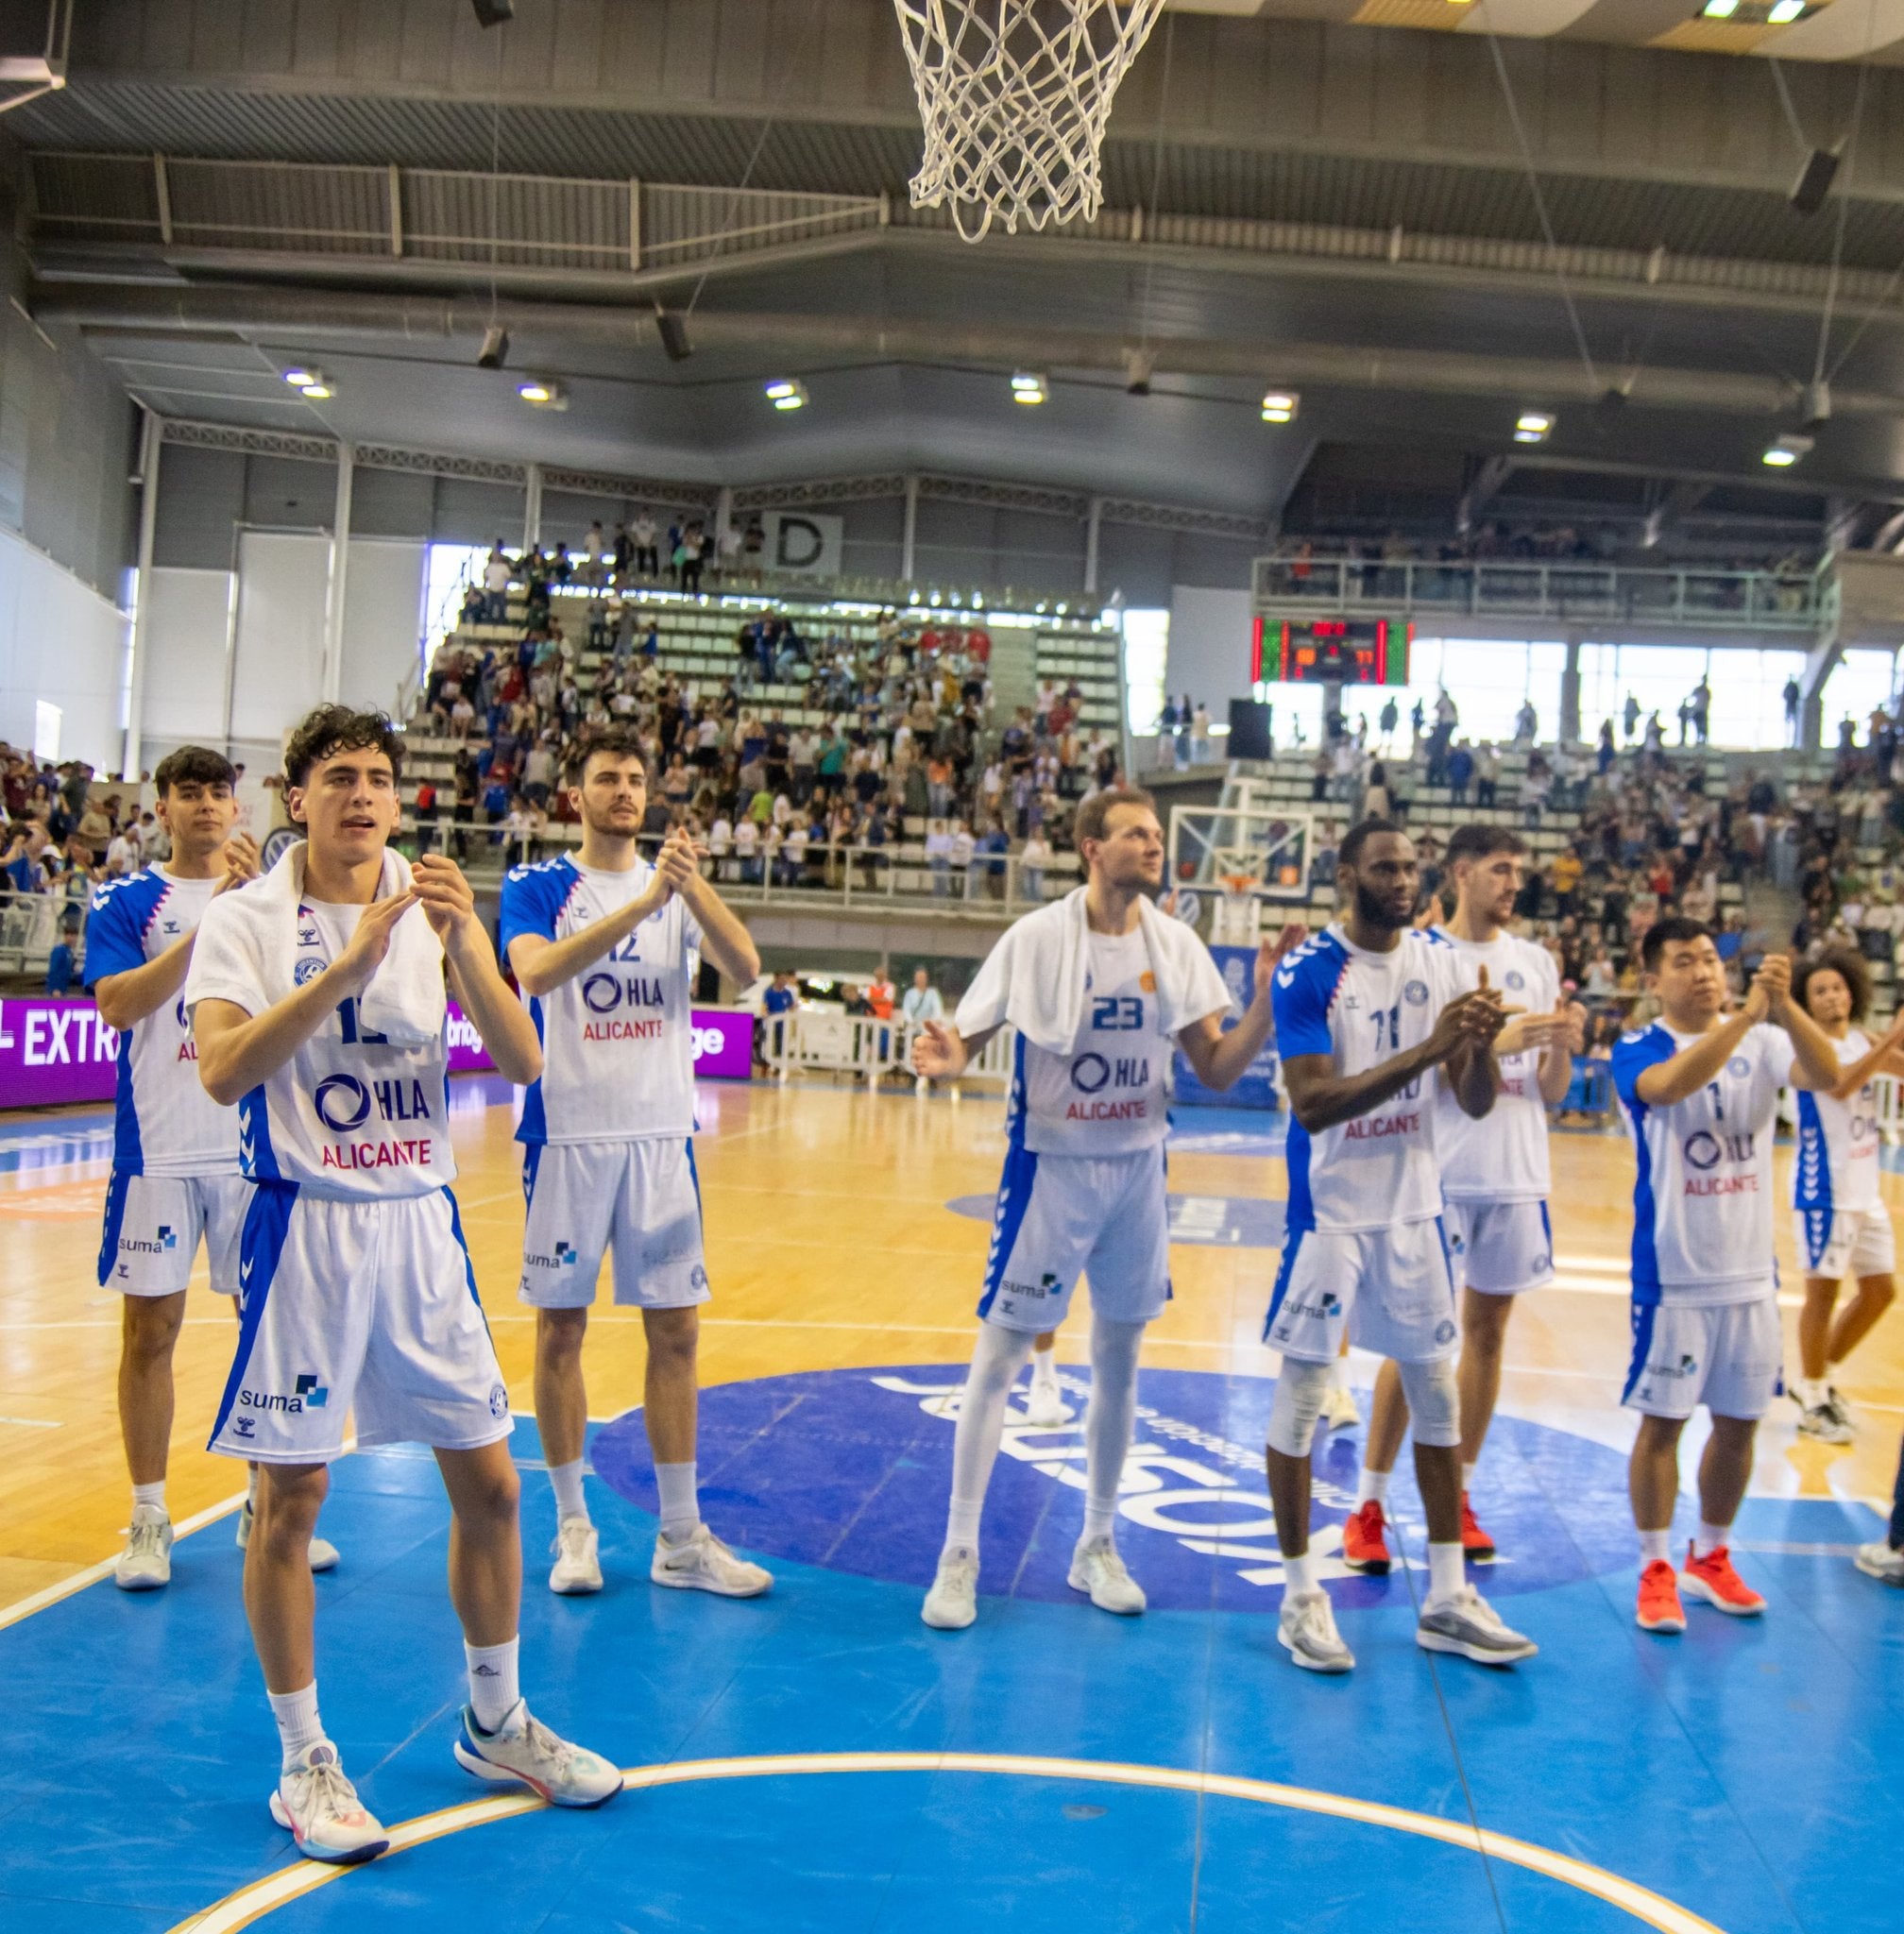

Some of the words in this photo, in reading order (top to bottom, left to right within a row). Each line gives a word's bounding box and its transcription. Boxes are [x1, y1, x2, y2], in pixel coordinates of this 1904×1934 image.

[776, 517, 824, 568] D
[1092, 997, 1144, 1031] 23
[24, 1009, 119, 1066] EXTR
[373, 1078, 431, 1122] HLA
[1065, 1099, 1148, 1121] ALICANTE
[1344, 1112, 1421, 1141] ALICANTE
[323, 1139, 433, 1170] ALICANTE
[119, 1238, 163, 1254] suma
[1002, 1280, 1046, 1300] suma
[240, 1389, 303, 1414] suma
